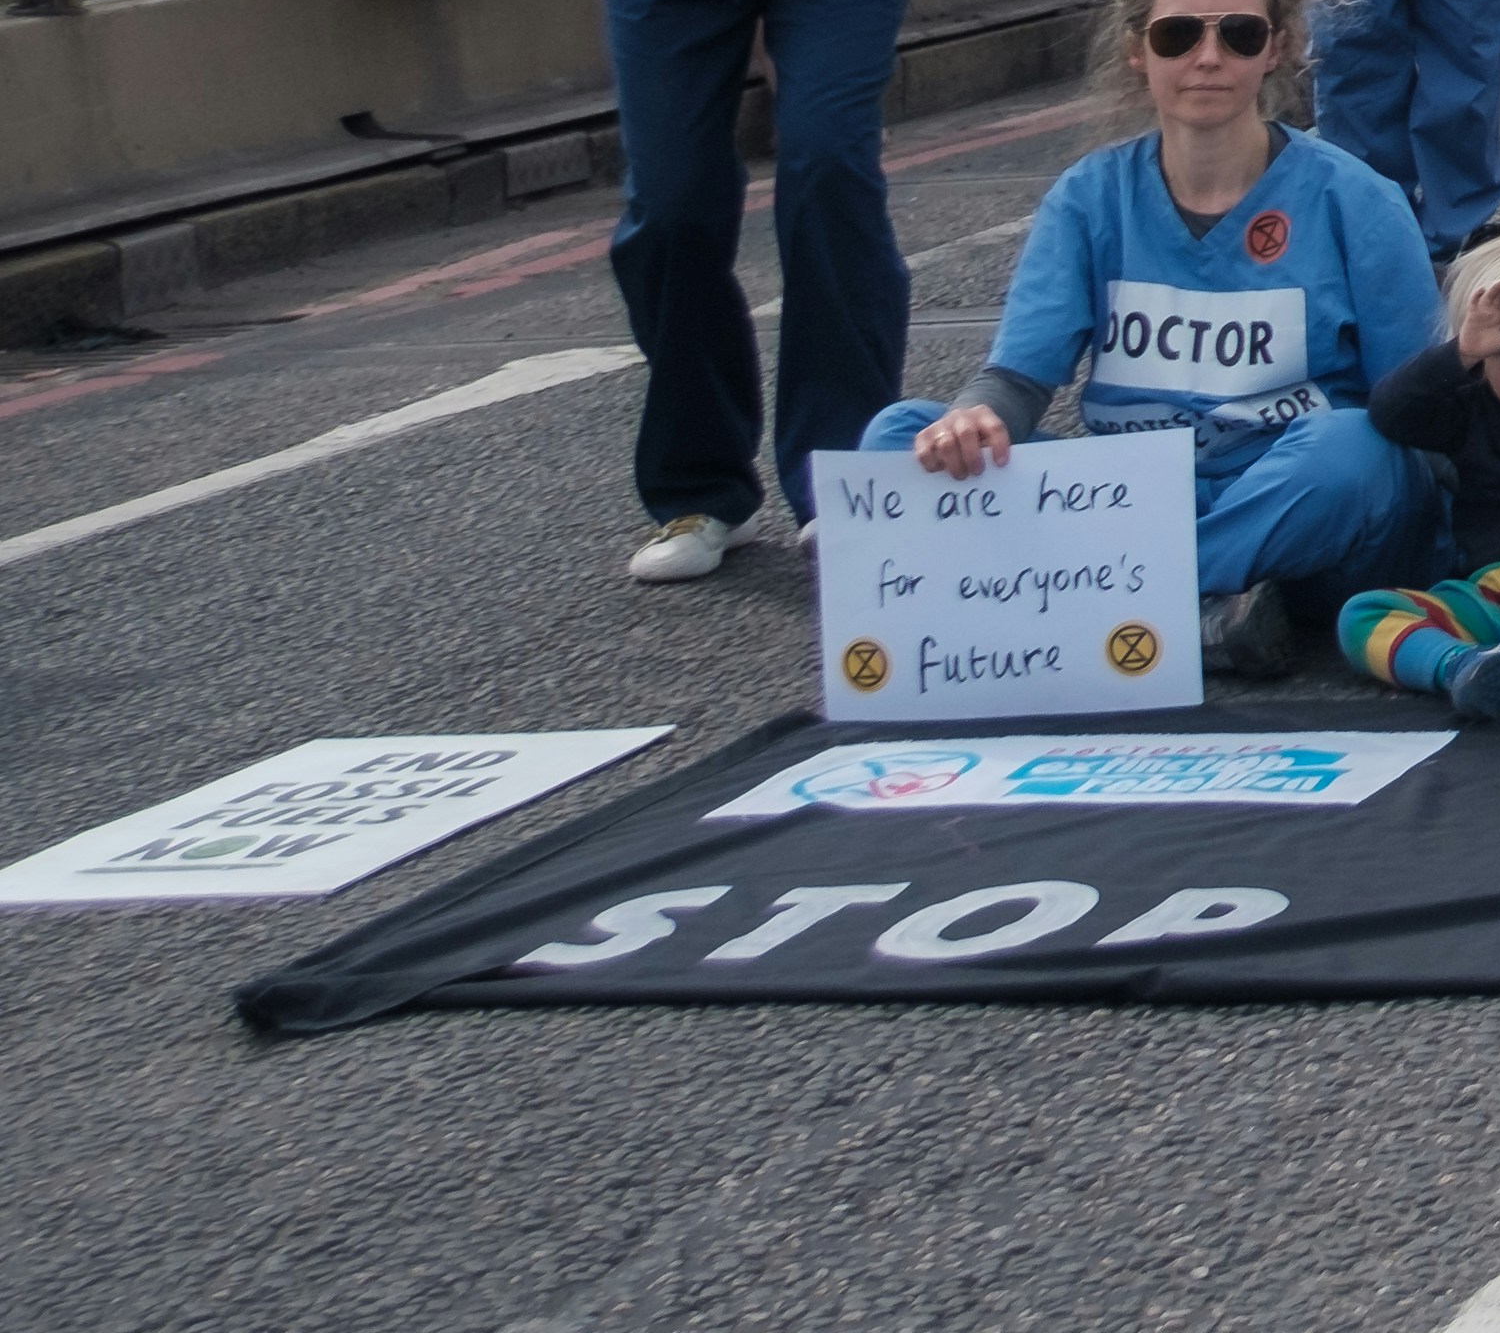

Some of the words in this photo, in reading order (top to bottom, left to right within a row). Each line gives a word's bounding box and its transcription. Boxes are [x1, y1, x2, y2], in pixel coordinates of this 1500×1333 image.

[842, 477, 905, 520] We
[937, 487, 1002, 520] are
[1037, 470, 1132, 513] here
[879, 559, 924, 608] for
[960, 554, 1146, 613] everyone's
[343, 750, 518, 774] END
[224, 776, 505, 804] FOSSIL
[168, 804, 430, 830] FUELS
[107, 833, 354, 862] NOW
[513, 881, 1292, 966] STOP
